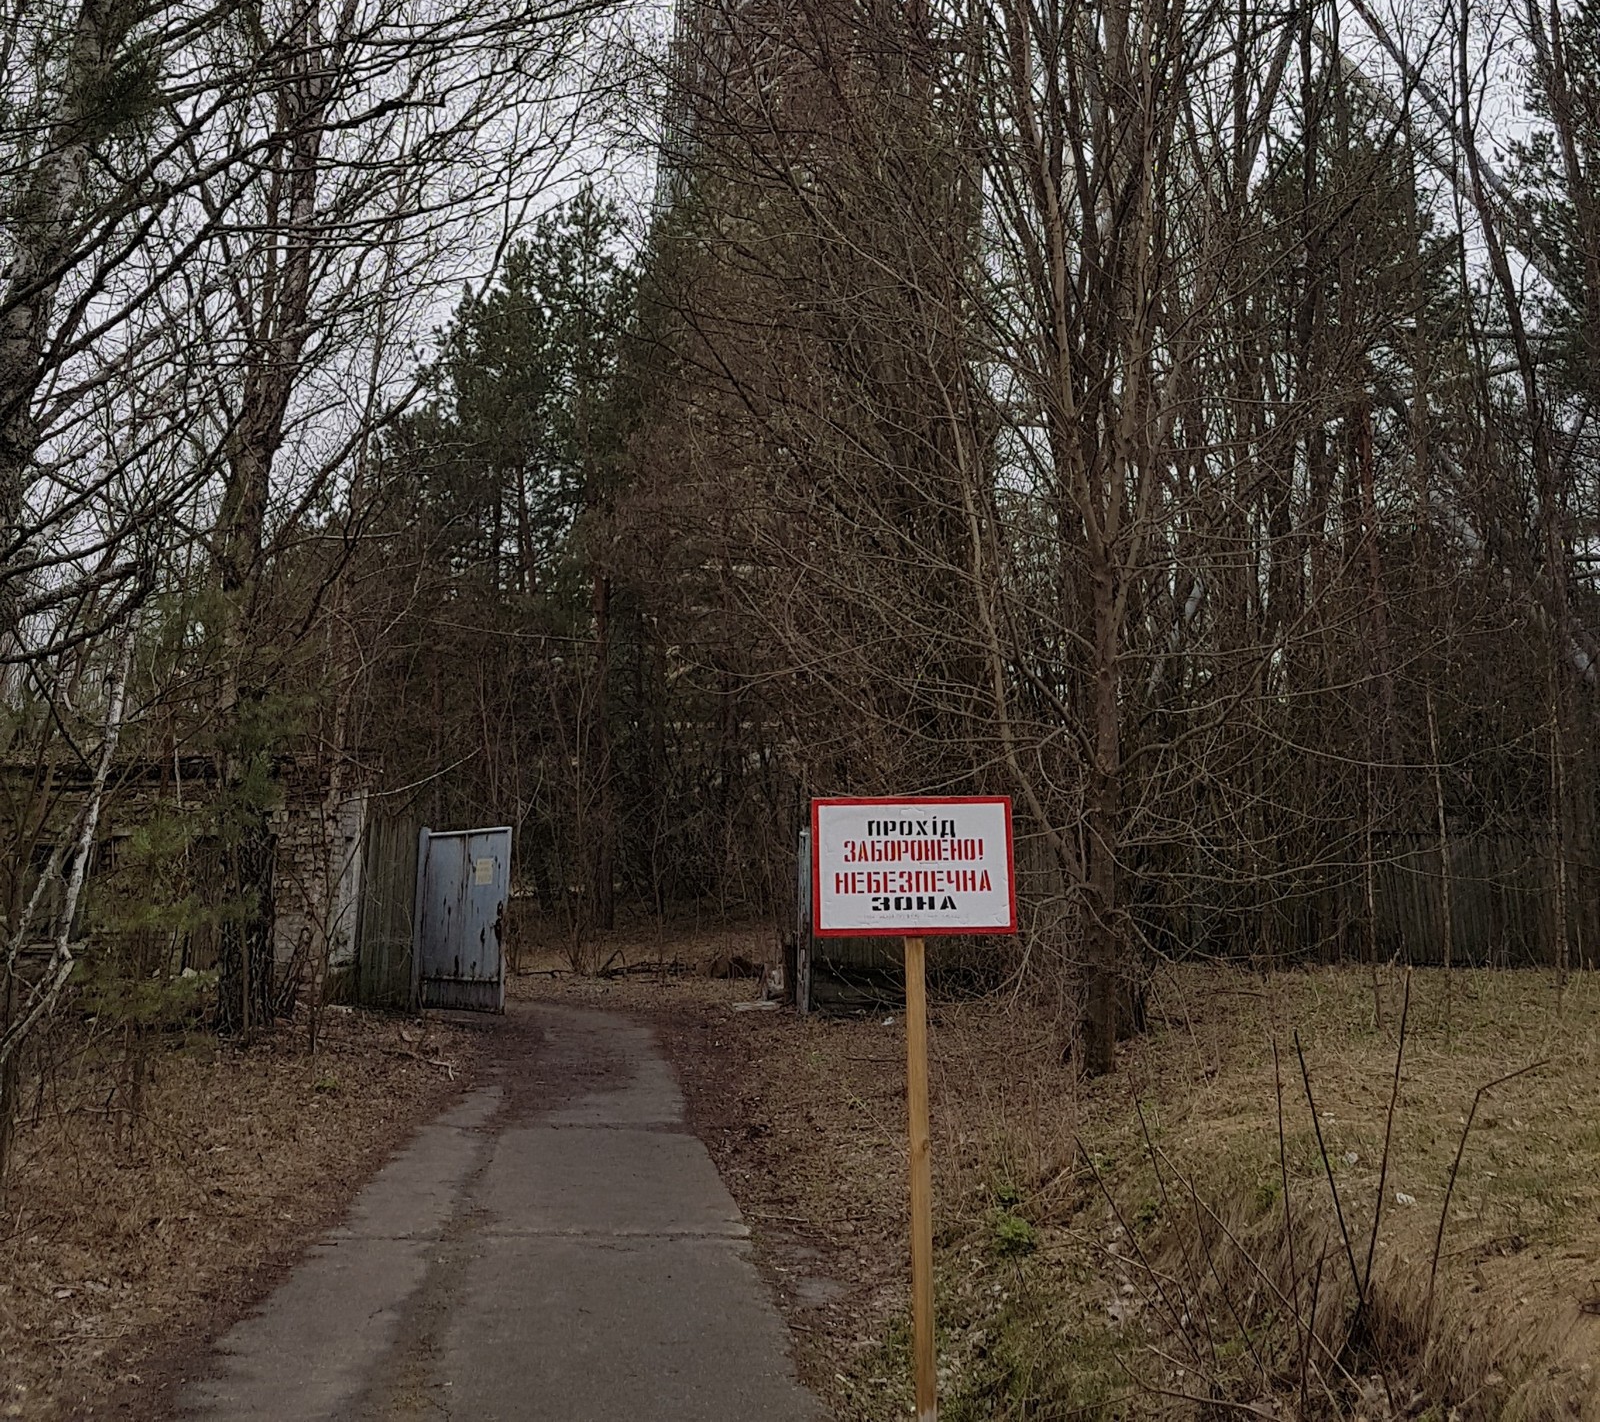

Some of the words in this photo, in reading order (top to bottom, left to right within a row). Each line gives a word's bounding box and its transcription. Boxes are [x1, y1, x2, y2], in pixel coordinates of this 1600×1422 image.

[843, 838, 985, 863] ЗАБОРОНЕНО!
[835, 869, 992, 894] НЕБЕЗПЕЧНА
[871, 896, 957, 911] ЗОНА
